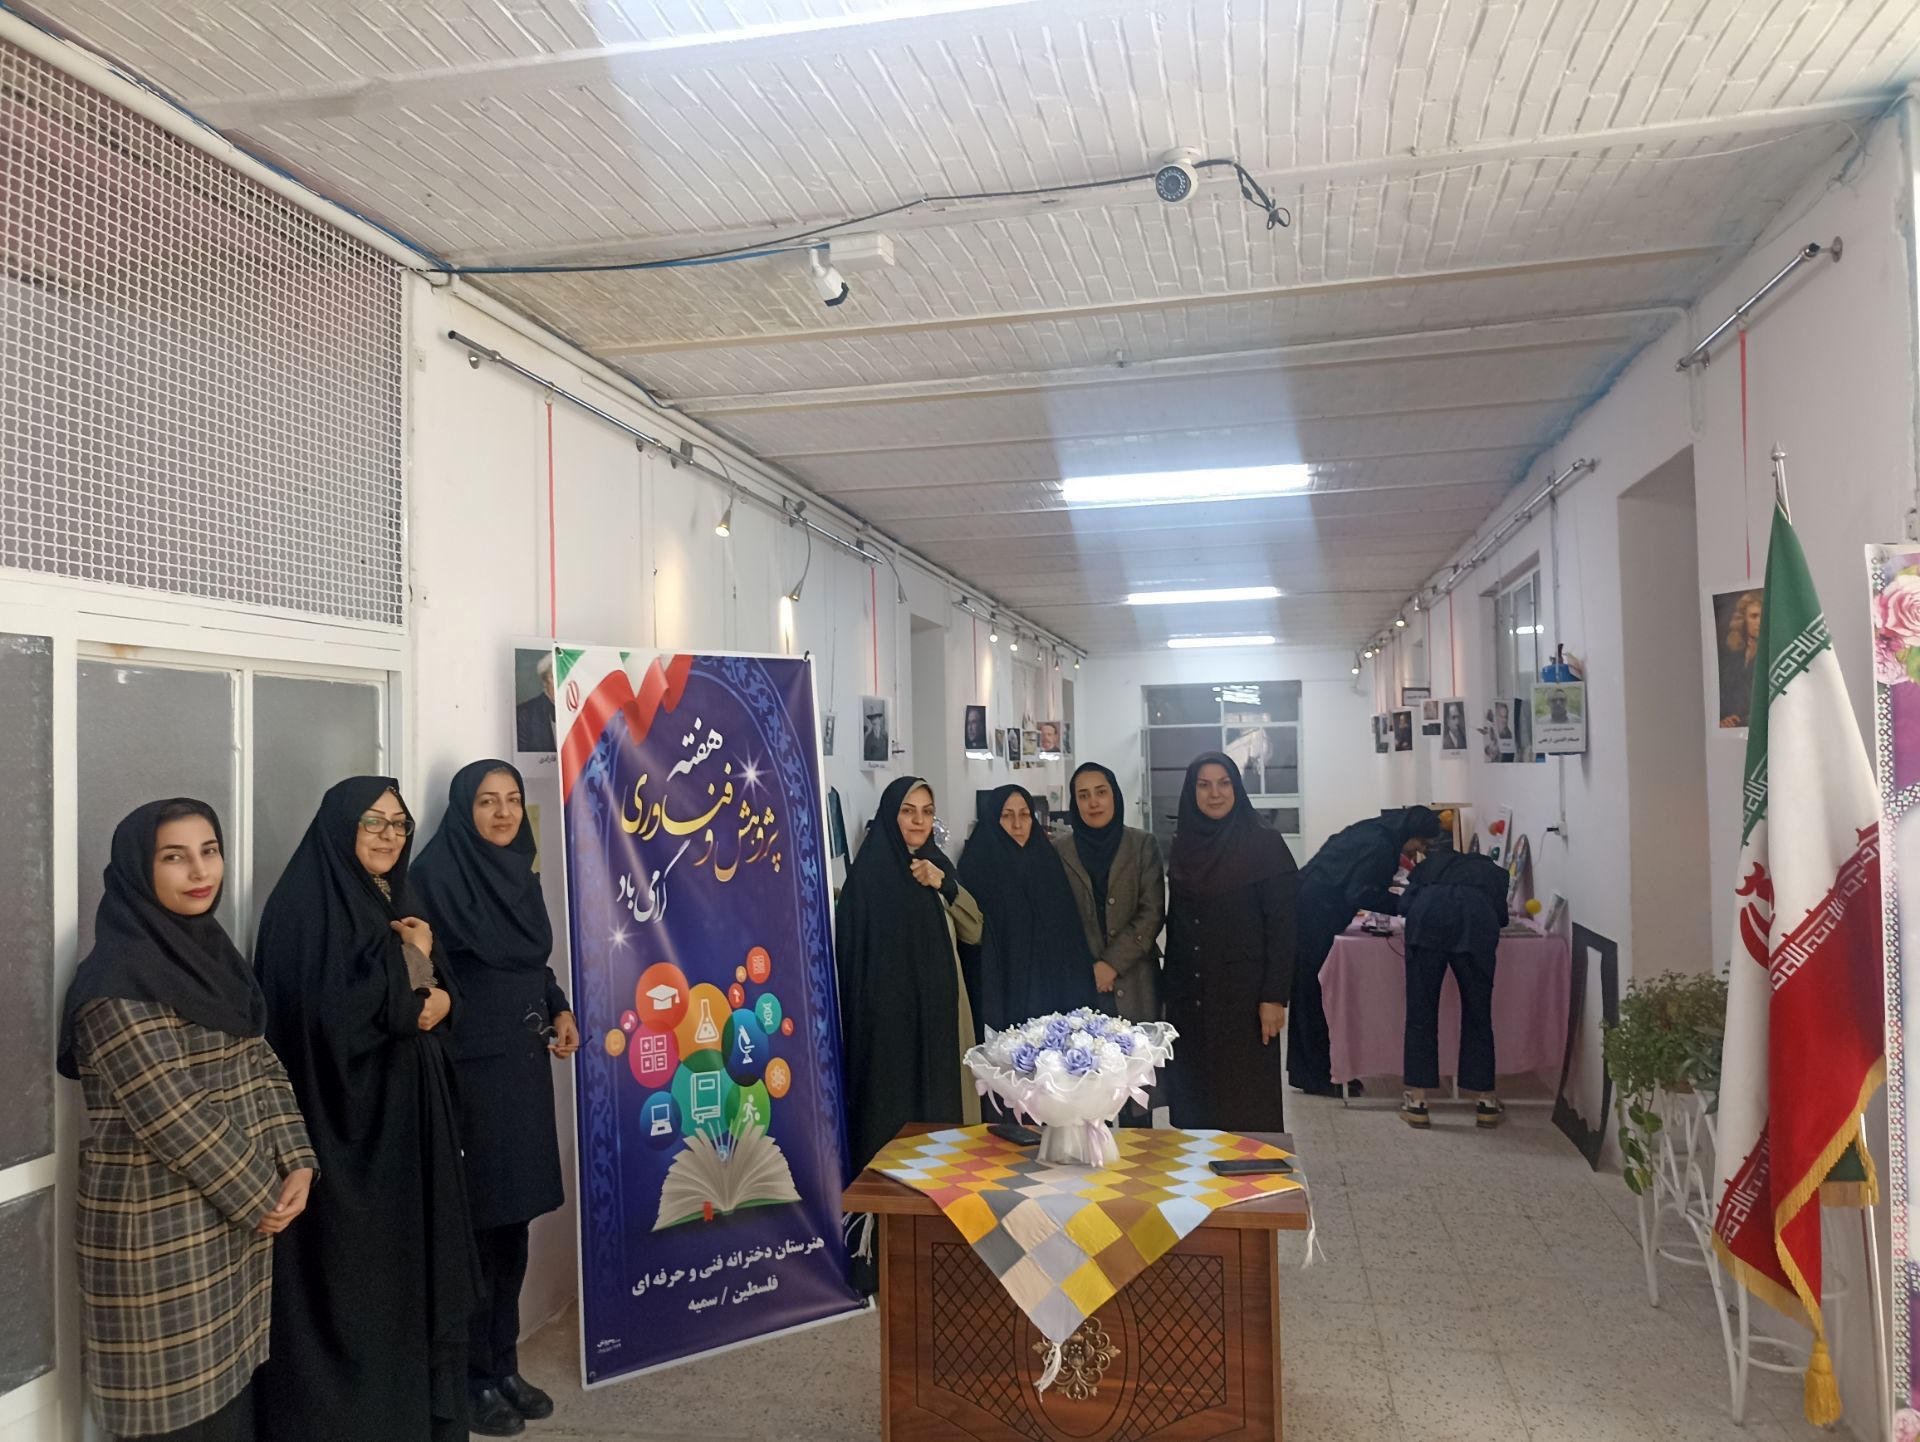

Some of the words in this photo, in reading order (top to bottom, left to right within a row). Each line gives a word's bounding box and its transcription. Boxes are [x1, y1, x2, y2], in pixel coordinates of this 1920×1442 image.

[667, 717, 724, 782] هفته
[621, 762, 734, 841] فناوری
[694, 828, 713, 867] و
[714, 799, 782, 882] پژوهش
[616, 872, 635, 911] باد
[726, 1244, 772, 1269] دخترانه
[774, 1236, 825, 1260] هنرستان
[652, 1267, 685, 1288] حرفه
[688, 1268, 697, 1283] و
[699, 1254, 723, 1279] فنی
[631, 1272, 650, 1297] ای
[732, 1274, 779, 1304] فلسطین
[687, 1296, 718, 1314] سمیه
